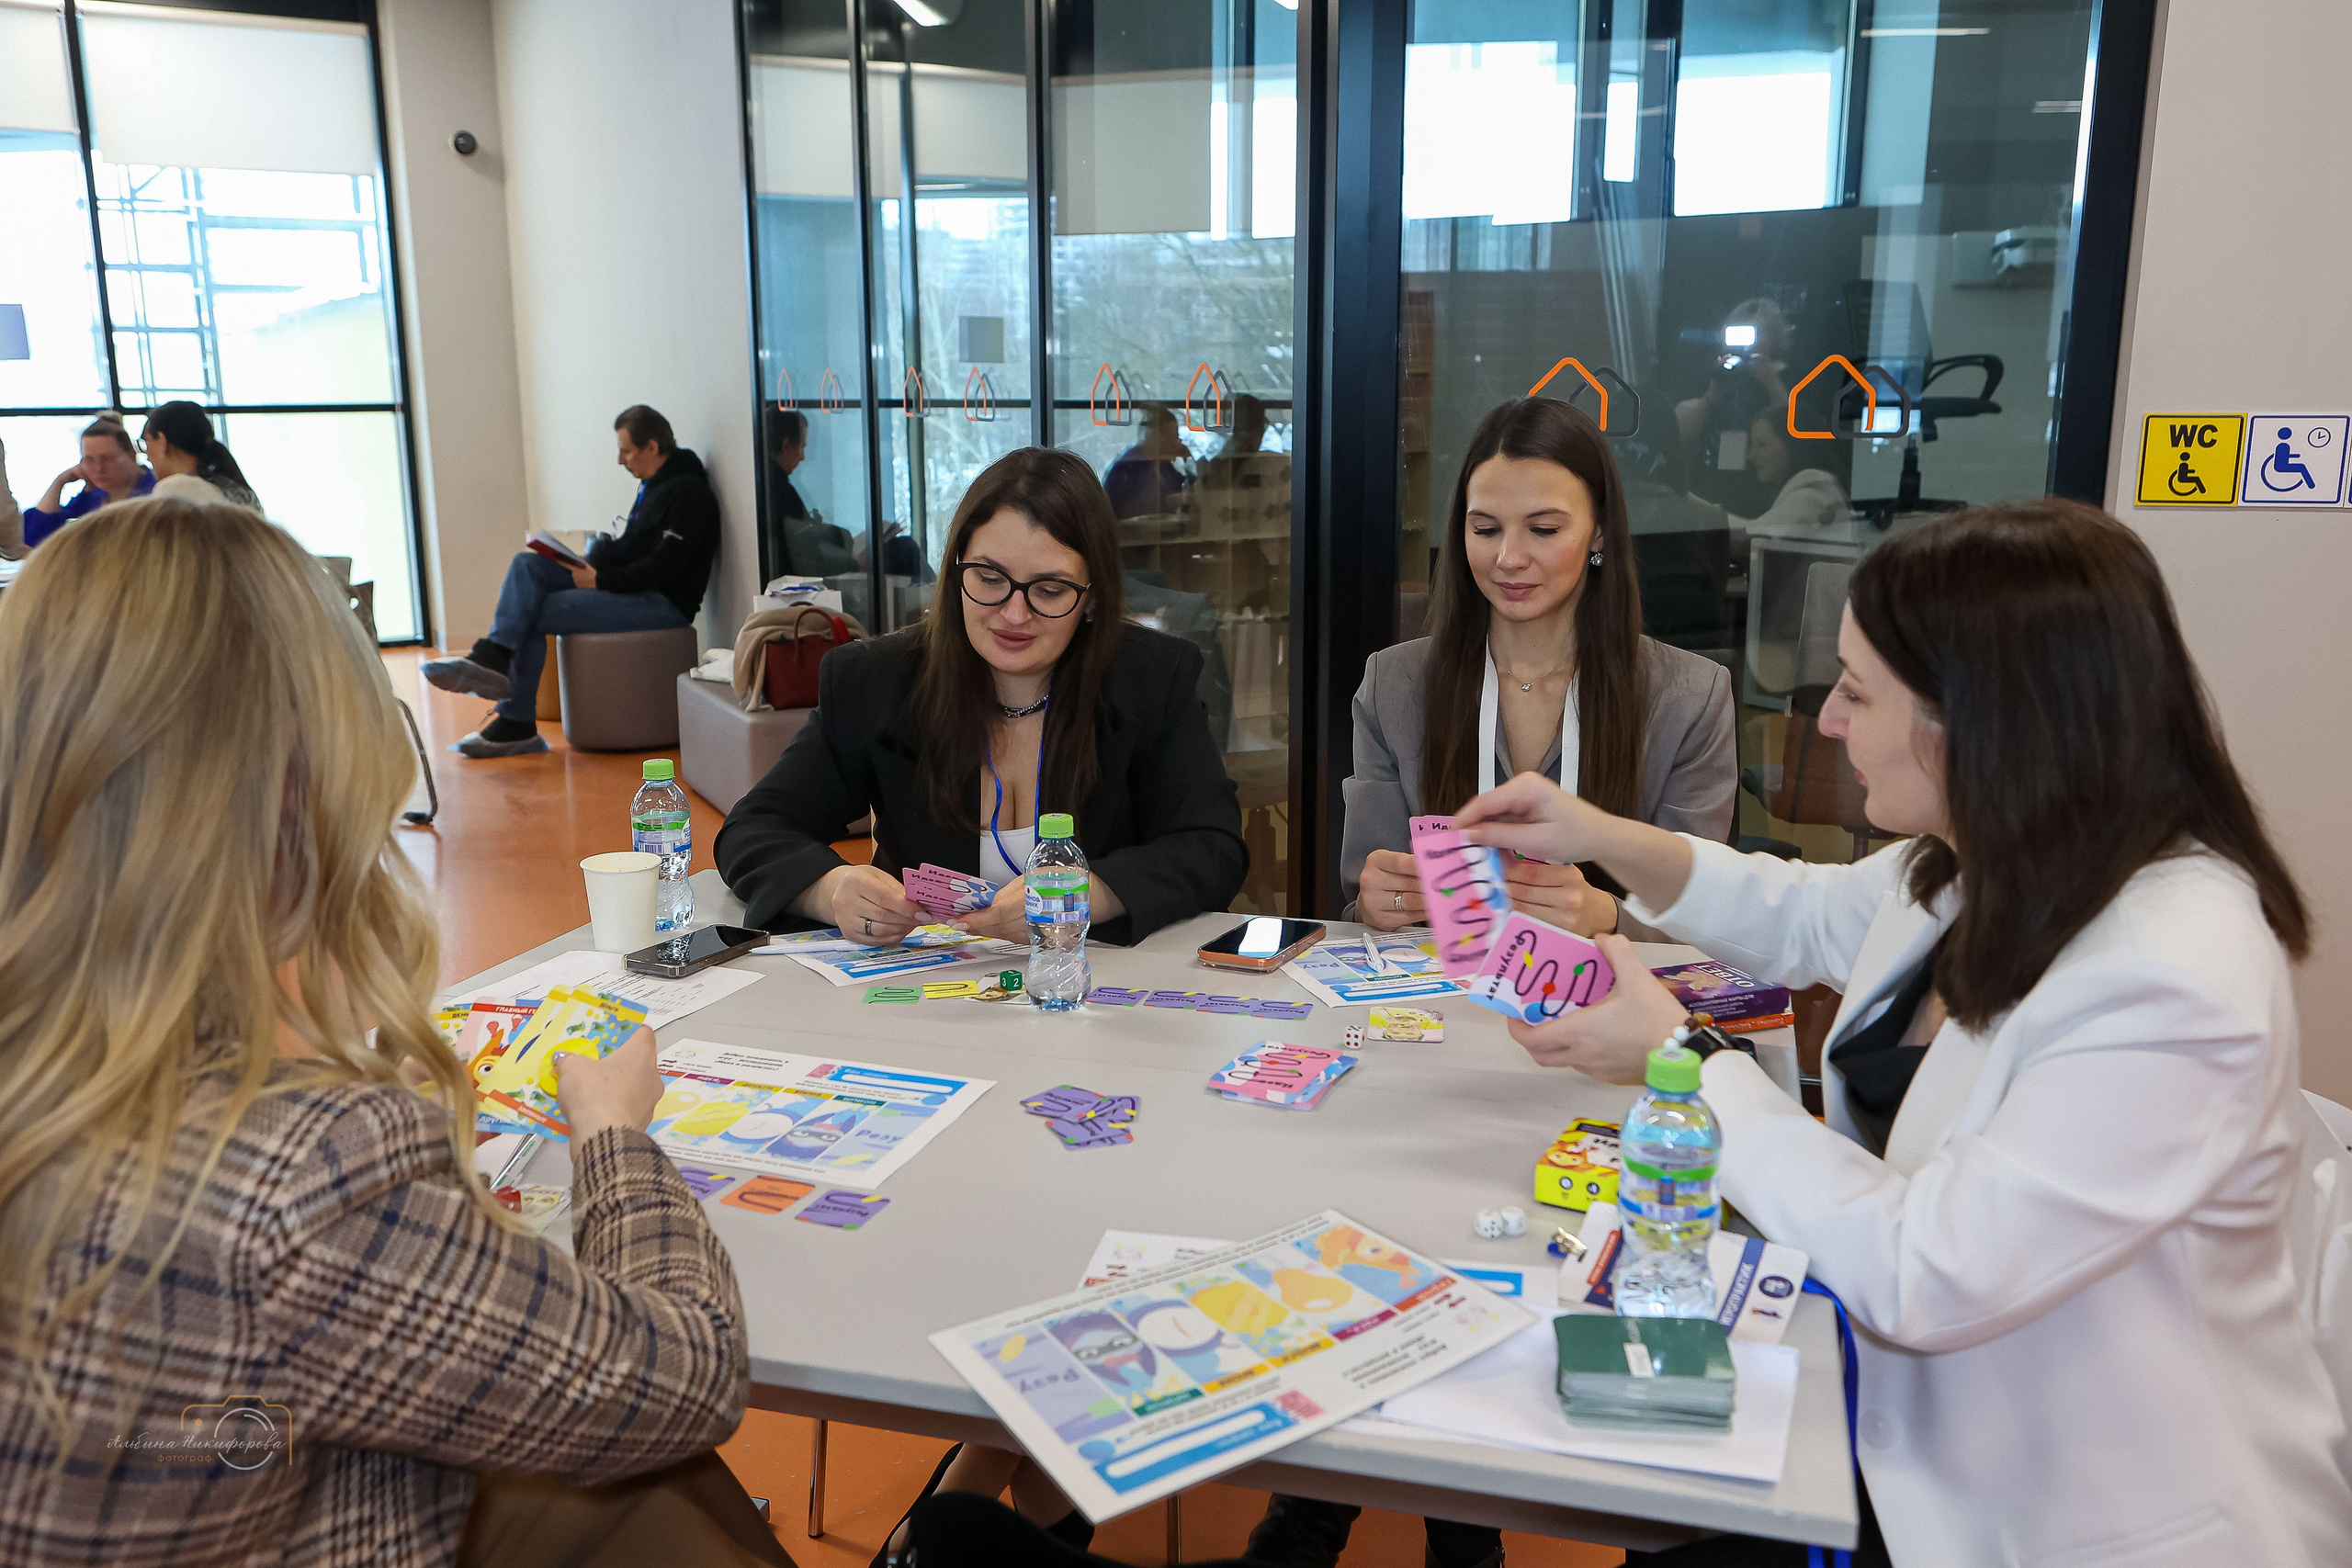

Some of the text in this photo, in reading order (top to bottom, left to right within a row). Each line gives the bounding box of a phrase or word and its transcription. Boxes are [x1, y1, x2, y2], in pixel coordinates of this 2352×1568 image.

[2169, 424, 2219, 448] WC
[1001, 977, 1007, 987] 3
[1012, 977, 1020, 987] 2
[1692, 964, 1756, 987] ОТВЕТ
